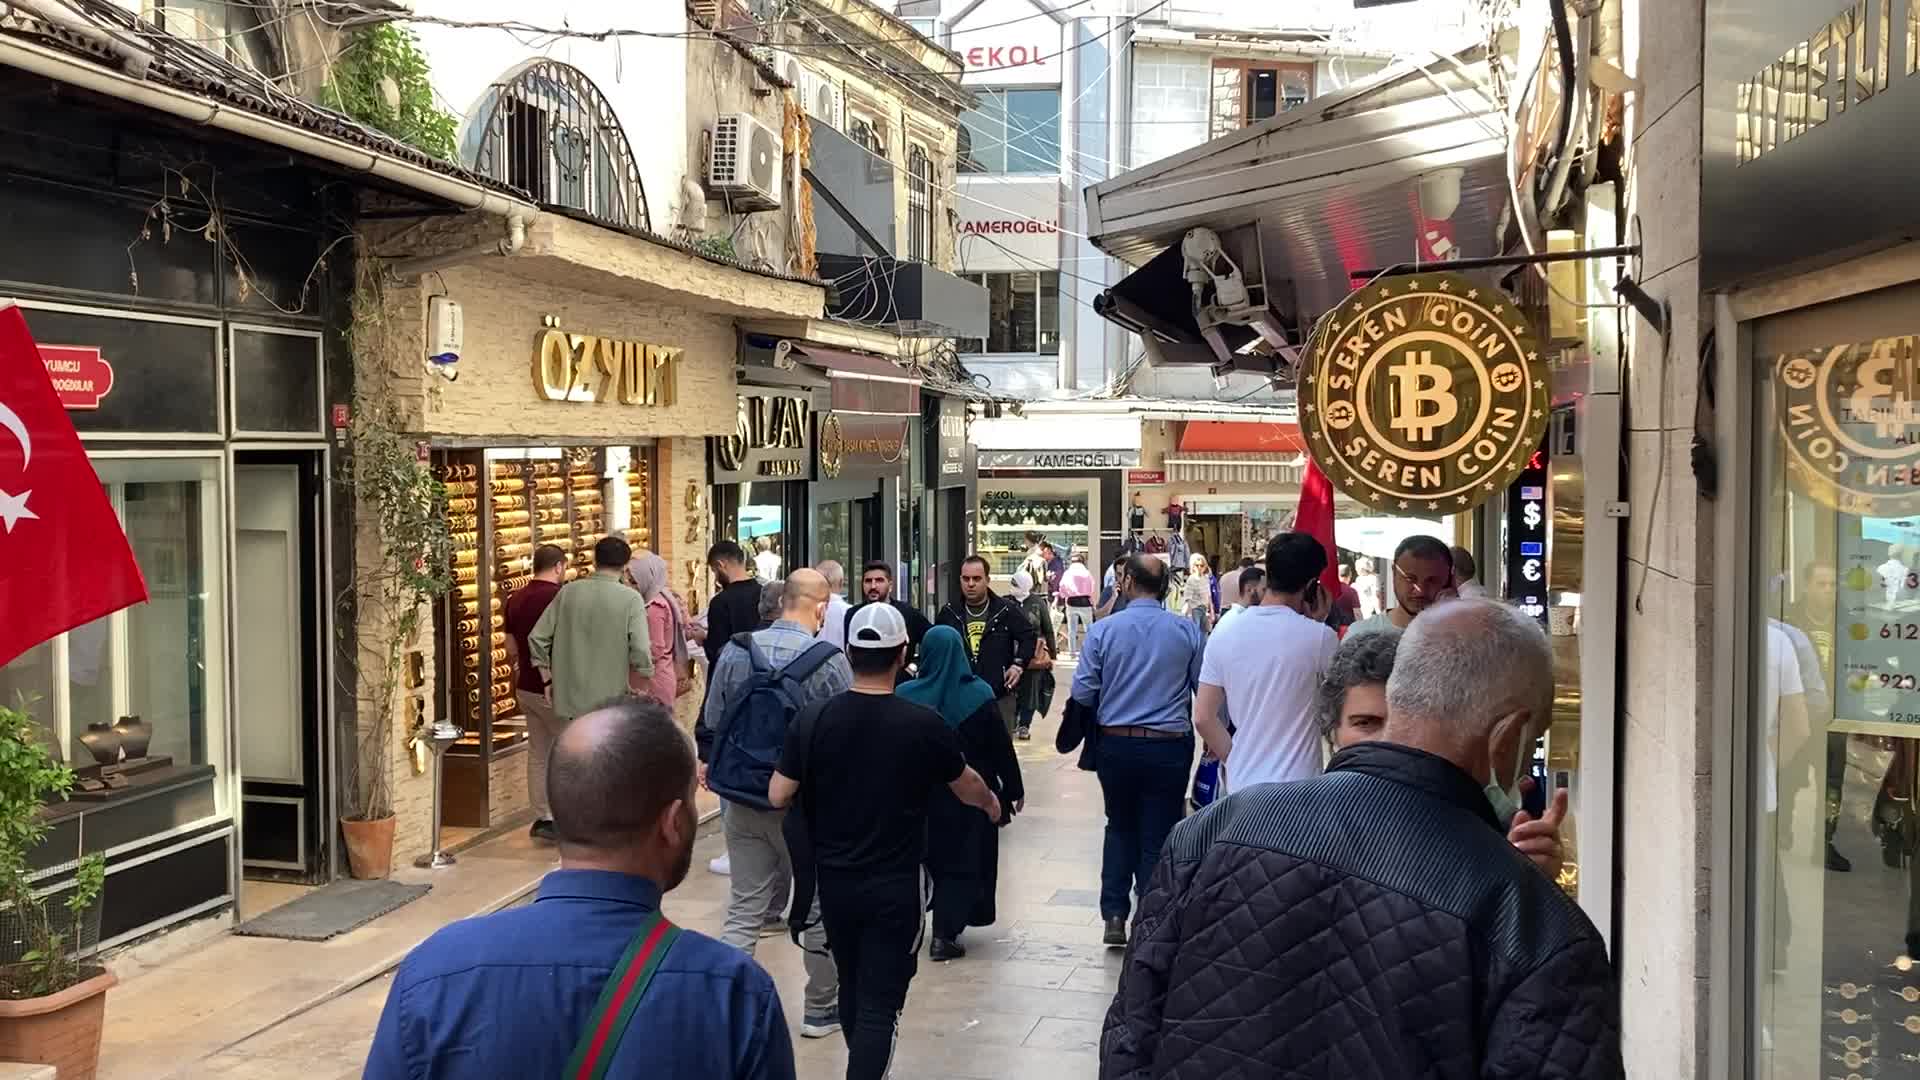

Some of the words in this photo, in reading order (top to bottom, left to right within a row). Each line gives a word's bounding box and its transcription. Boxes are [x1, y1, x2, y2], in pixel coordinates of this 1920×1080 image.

[967, 45, 1047, 67] EKOL
[1034, 450, 1122, 467] KAMEROĞLU
[985, 490, 1016, 500] EKOL
